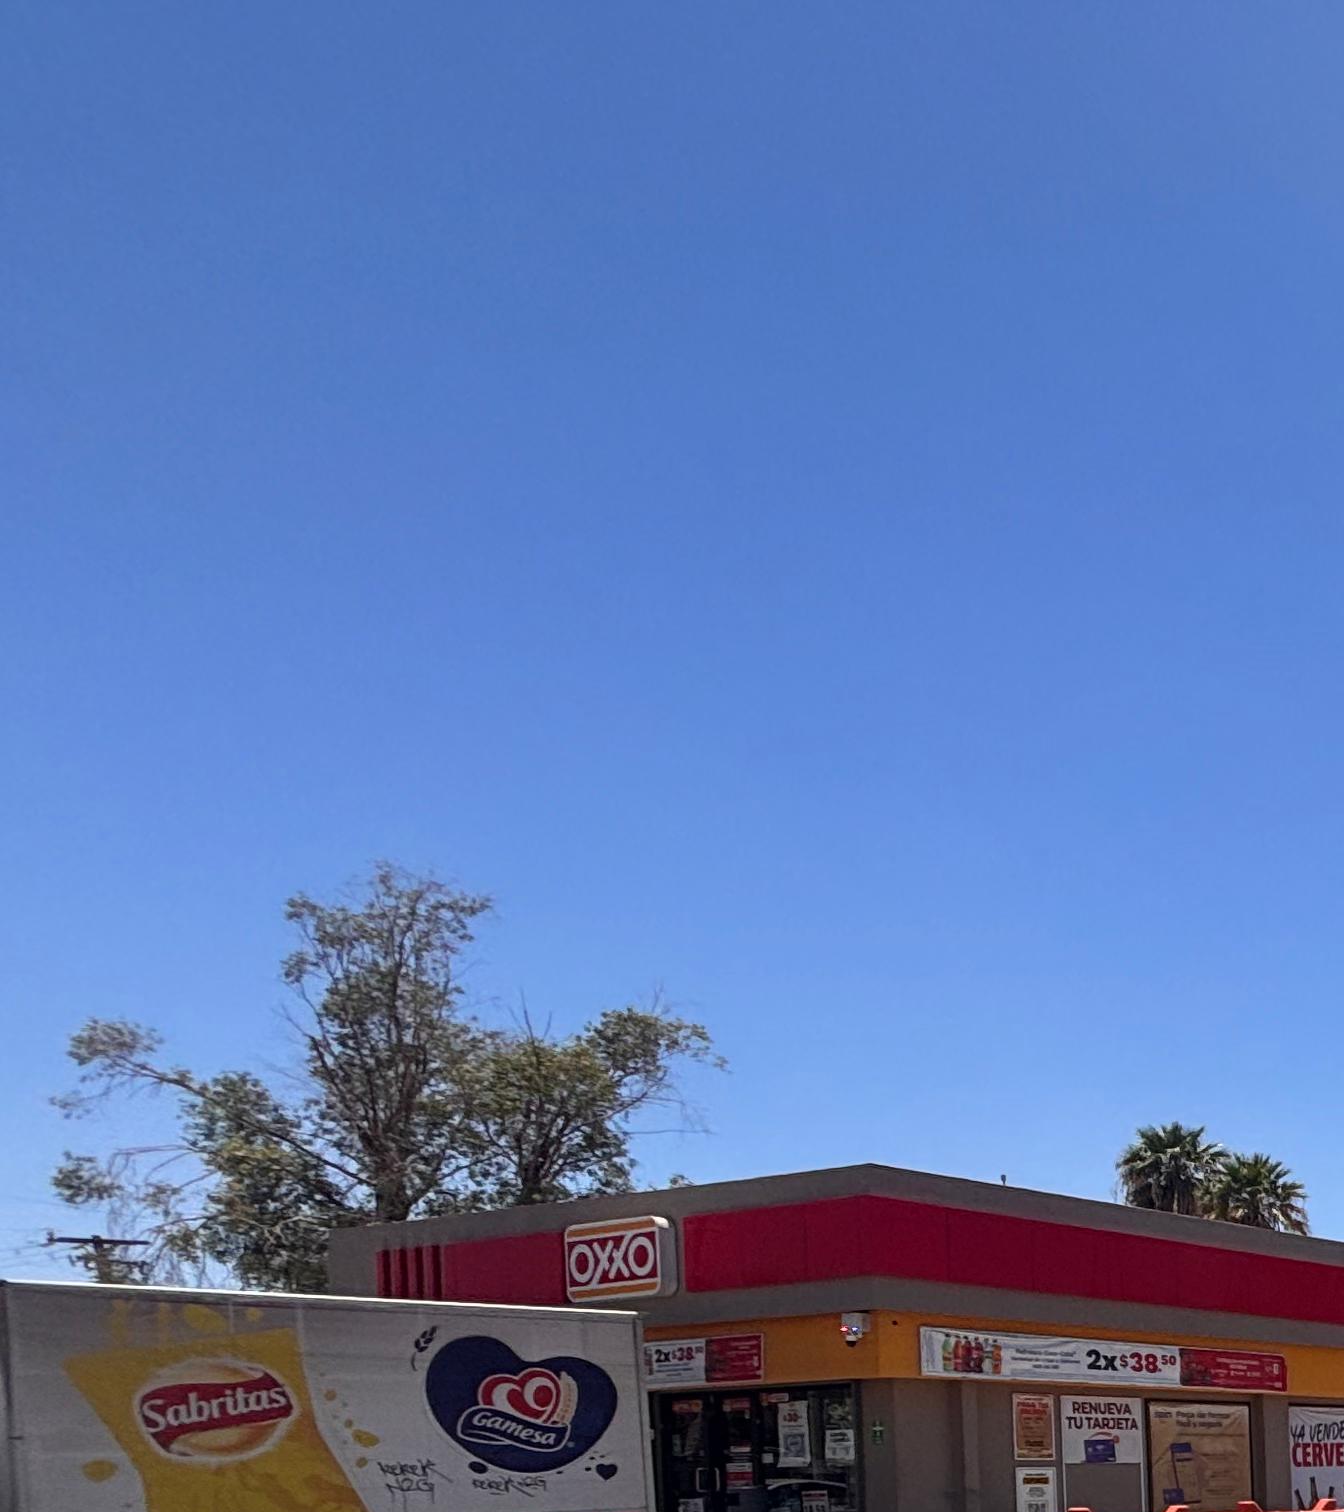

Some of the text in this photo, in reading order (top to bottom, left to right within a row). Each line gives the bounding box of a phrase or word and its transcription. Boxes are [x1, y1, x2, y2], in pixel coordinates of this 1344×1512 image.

[570, 1233, 656, 1288] OXXO
[142, 1386, 289, 1433] Sabritas
[1072, 1401, 1132, 1415] RENUEVA
[471, 1411, 557, 1445] Gamesa
[1066, 1416, 1138, 1430] TU TARJETA
[1290, 1423, 1305, 1443] YA
